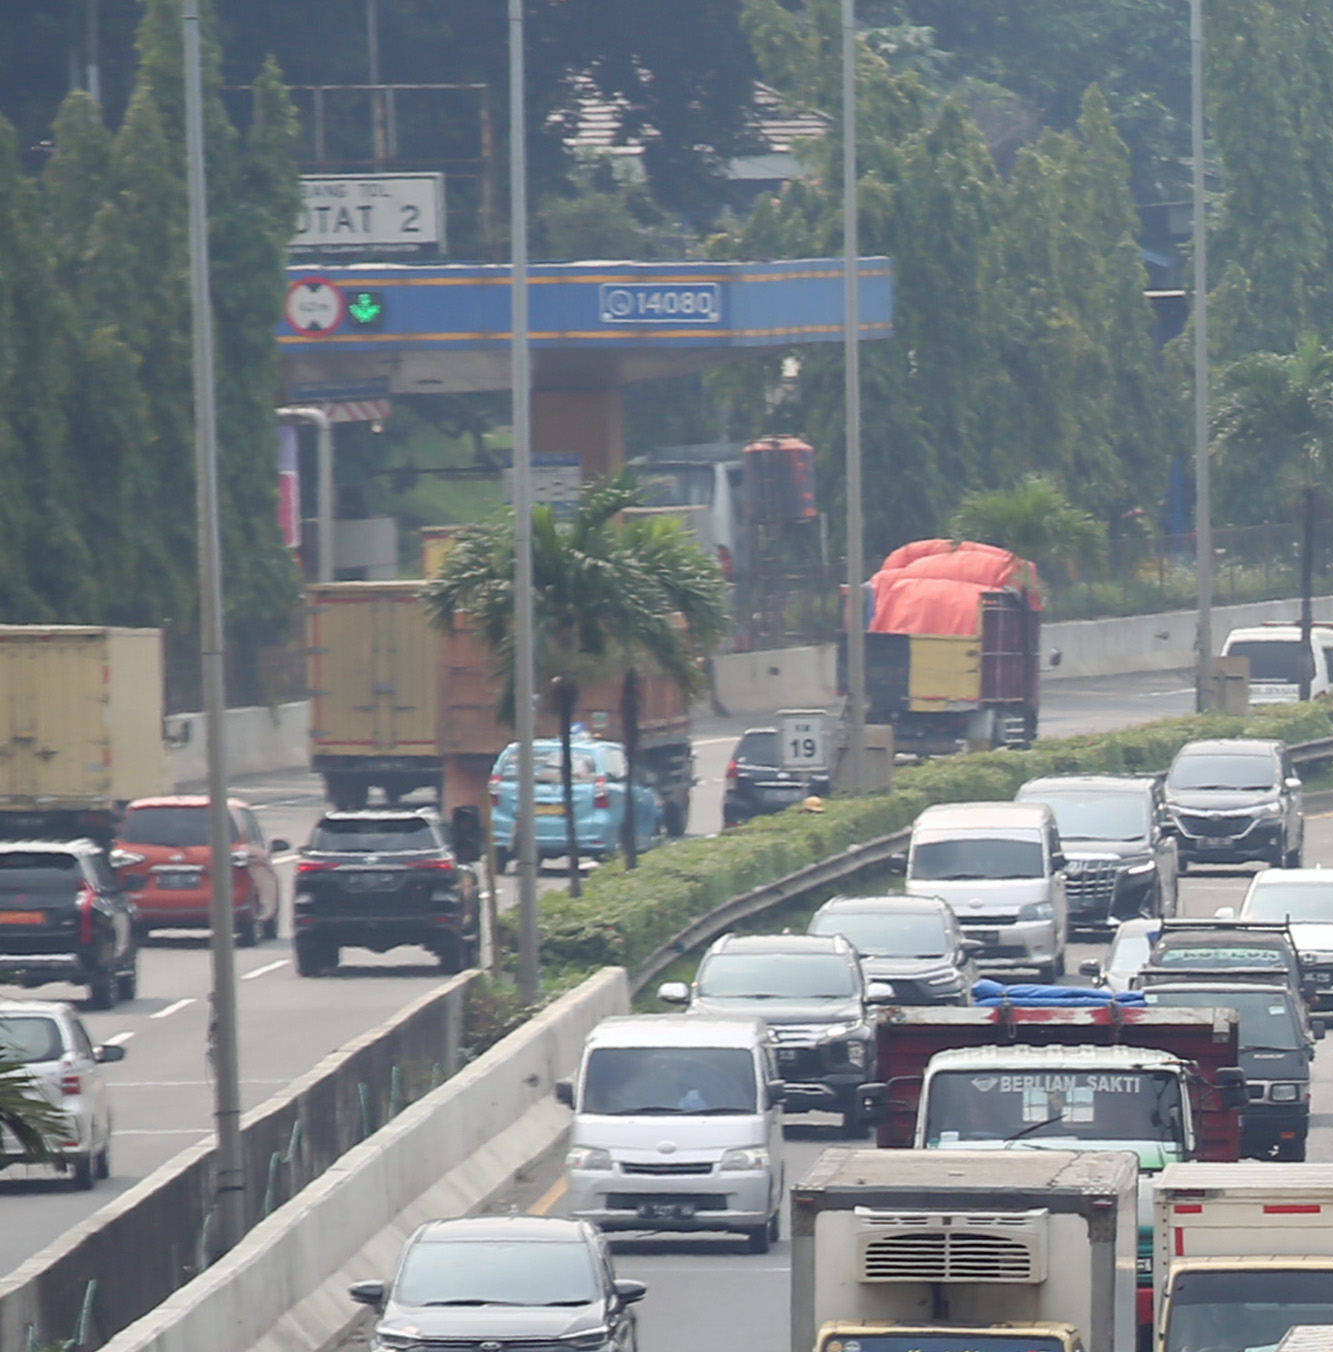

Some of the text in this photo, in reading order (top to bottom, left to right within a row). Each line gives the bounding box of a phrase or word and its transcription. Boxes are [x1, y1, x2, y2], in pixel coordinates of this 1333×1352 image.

[400, 204, 421, 233] 2
[637, 292, 713, 314] 14080
[789, 738, 816, 758] 19
[999, 1075, 1140, 1093] BERLIAN SAKTI
